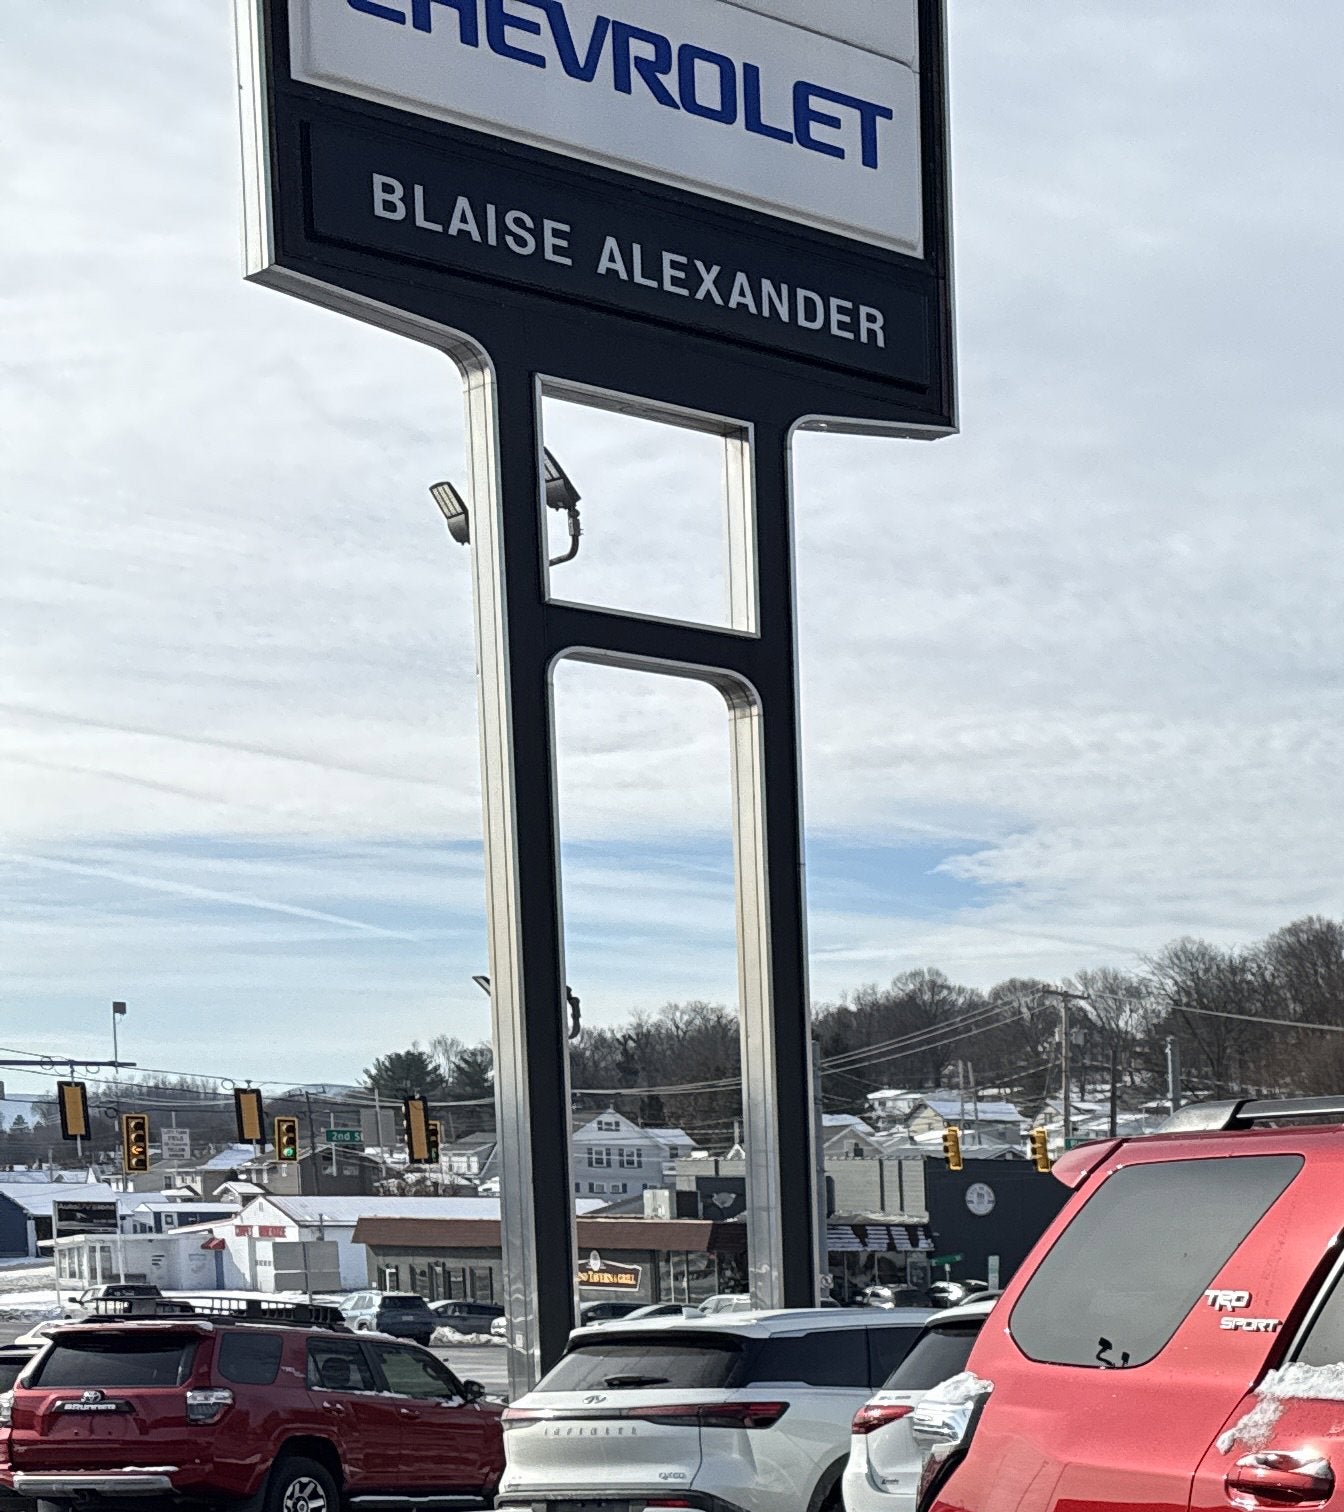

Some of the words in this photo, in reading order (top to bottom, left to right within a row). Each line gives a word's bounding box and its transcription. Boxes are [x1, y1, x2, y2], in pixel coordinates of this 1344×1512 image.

[373, 172, 574, 267] BLAISE
[597, 235, 887, 350] ALEXANDER
[332, 1132, 350, 1141] 2nd
[1204, 1288, 1252, 1312] TRD
[1219, 1317, 1283, 1332] SPORT
